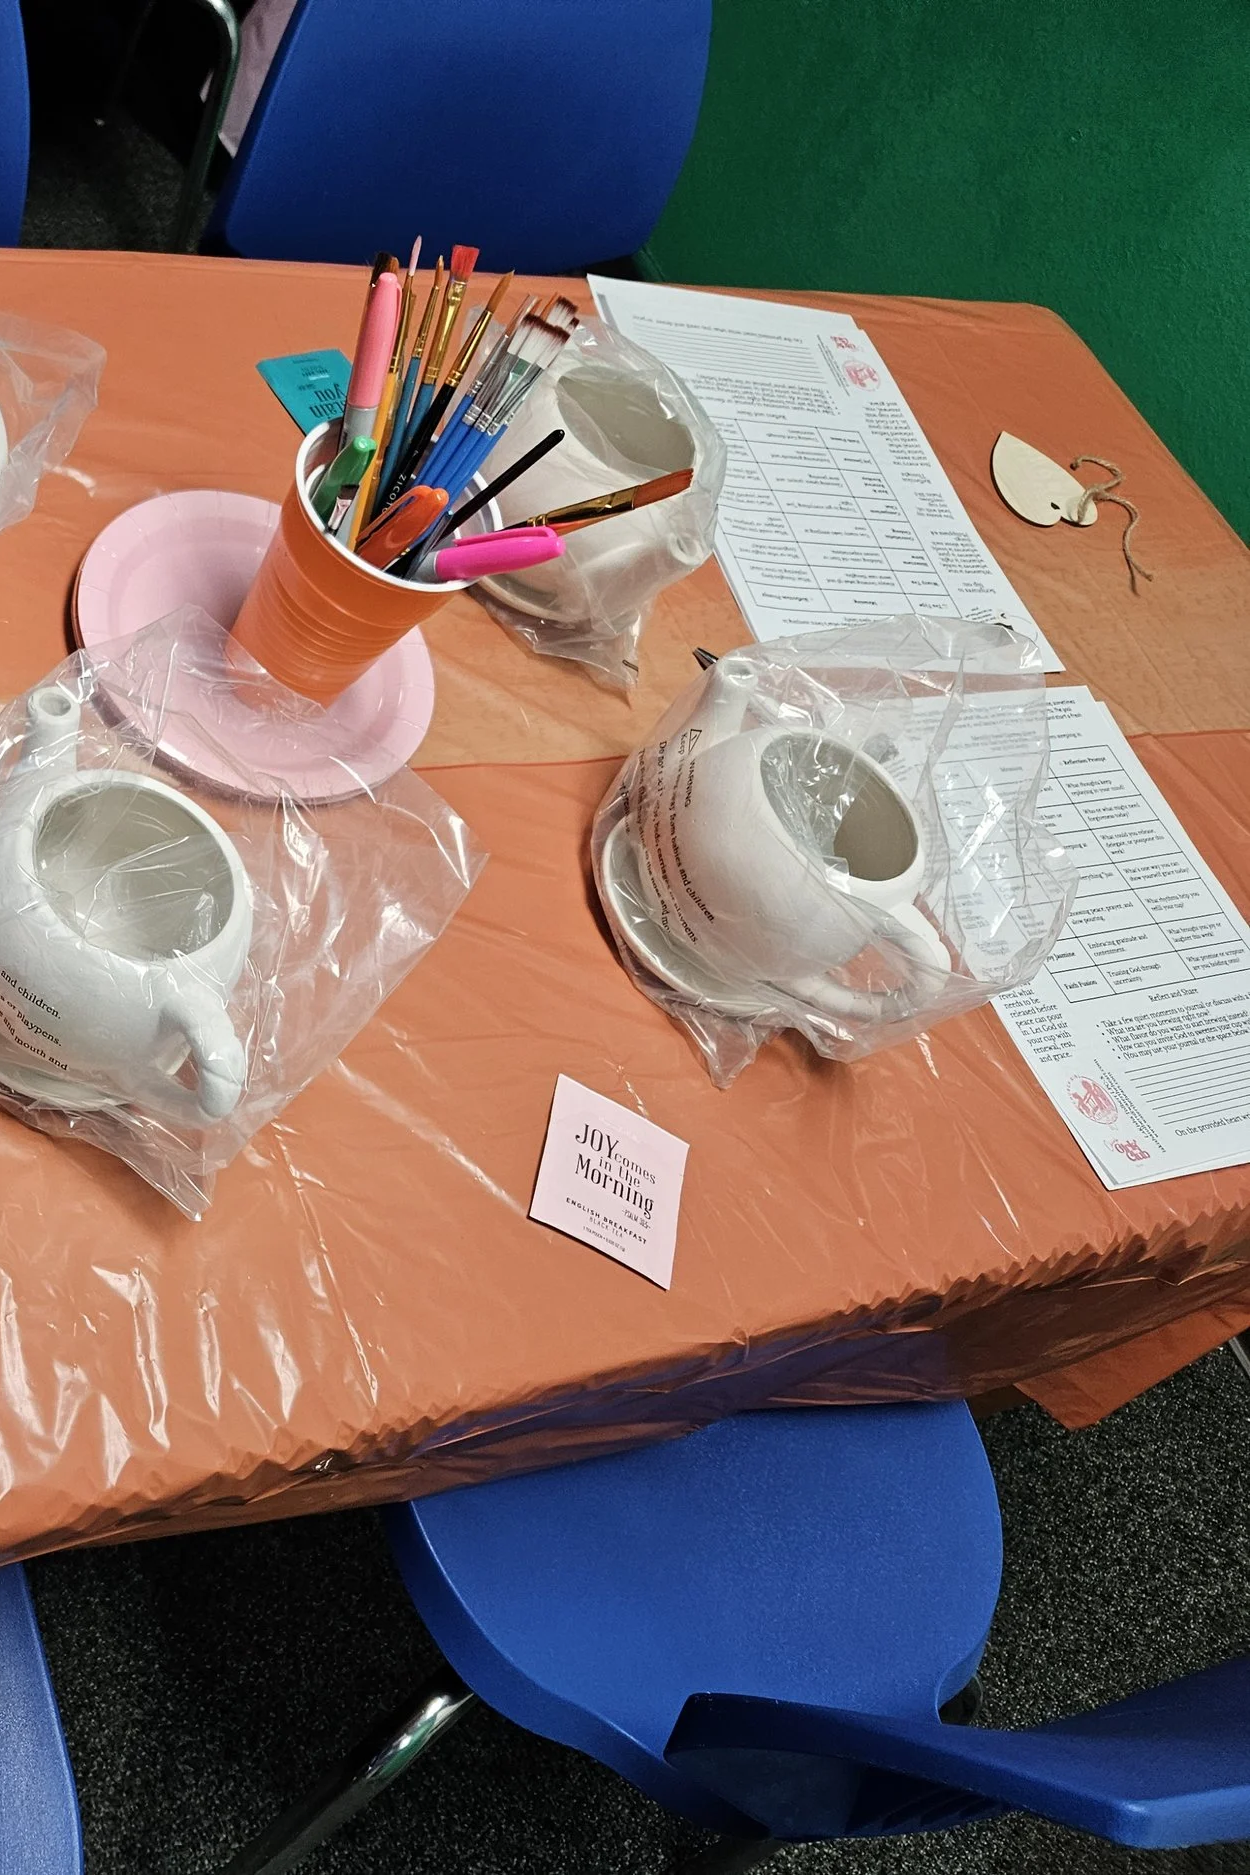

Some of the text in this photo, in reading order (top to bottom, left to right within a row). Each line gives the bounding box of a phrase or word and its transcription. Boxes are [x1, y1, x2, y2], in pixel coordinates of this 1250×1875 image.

[314, 383, 345, 403] you
[671, 835, 682, 868] babies
[679, 868, 690, 886] and
[686, 884, 714, 924] children.
[0, 970, 61, 1020] and children.
[999, 989, 1035, 1001] reveal what
[1004, 1000, 1023, 1009] needs
[1010, 1004, 1058, 1018] released before
[3, 1017, 15, 1036] and
[14, 1035, 46, 1058] mouth
[48, 1056, 68, 1071] and
[16, 1010, 62, 1047] playpens.
[1039, 1054, 1053, 1063] and
[575, 1124, 656, 1185] JOY comes
[575, 1154, 655, 1219] Morning
[599, 1156, 640, 1188] in the
[566, 1197, 600, 1218] ENGLISH
[603, 1216, 647, 1244] BREAKFAST
[589, 1217, 623, 1238] BLACK TEA
